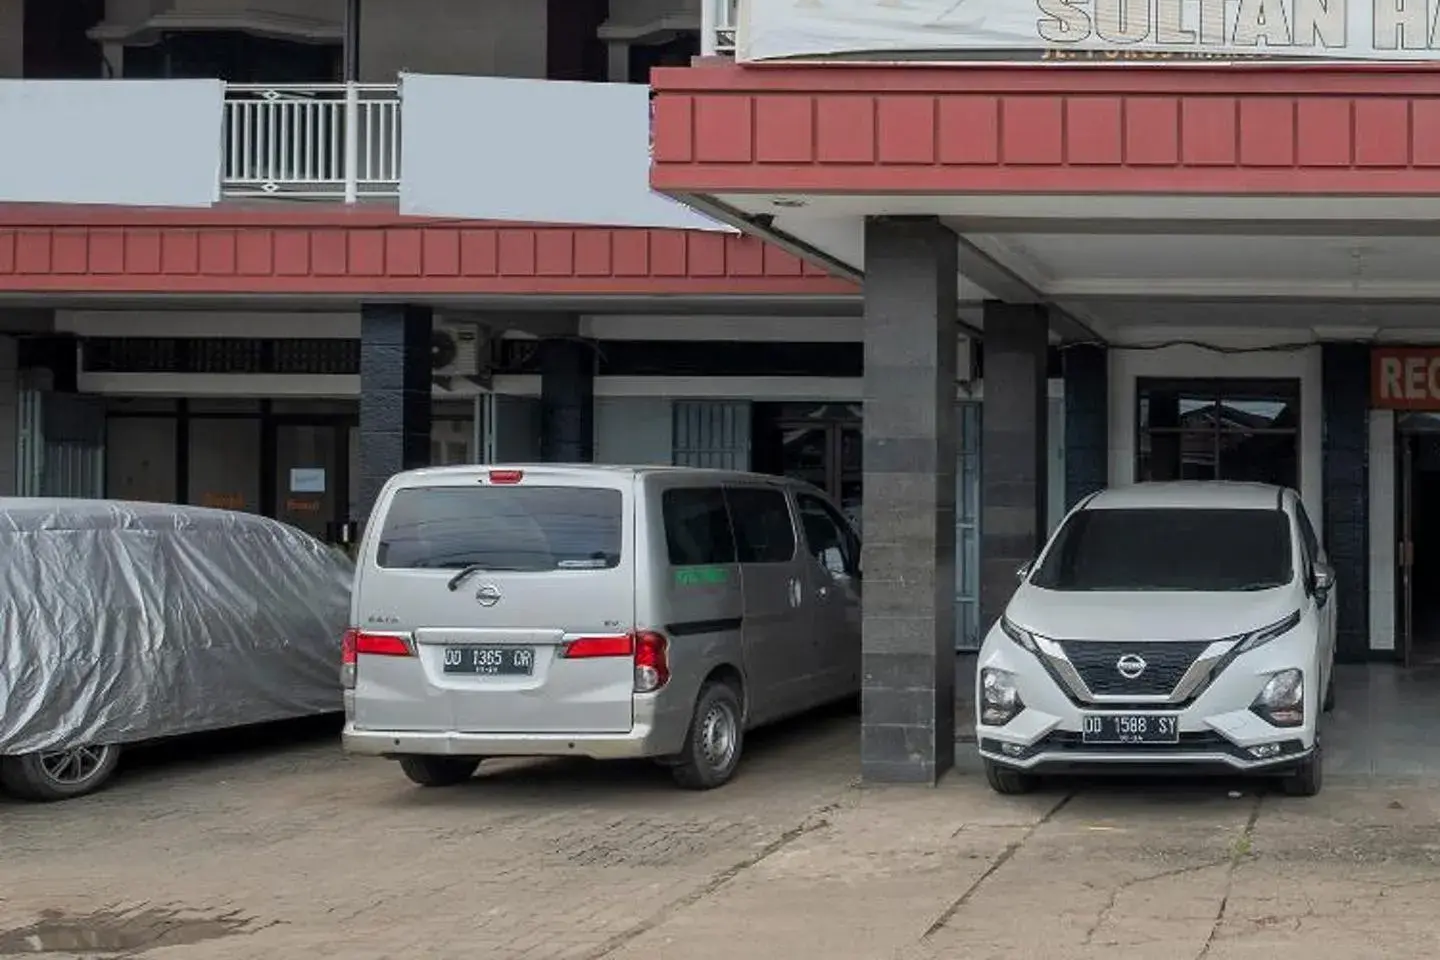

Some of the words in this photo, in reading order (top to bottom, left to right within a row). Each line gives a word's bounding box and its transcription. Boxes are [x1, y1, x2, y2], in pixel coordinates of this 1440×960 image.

[473, 650, 503, 665] 1365
[1114, 717, 1147, 733] 1588
[1158, 717, 1176, 734] SY
